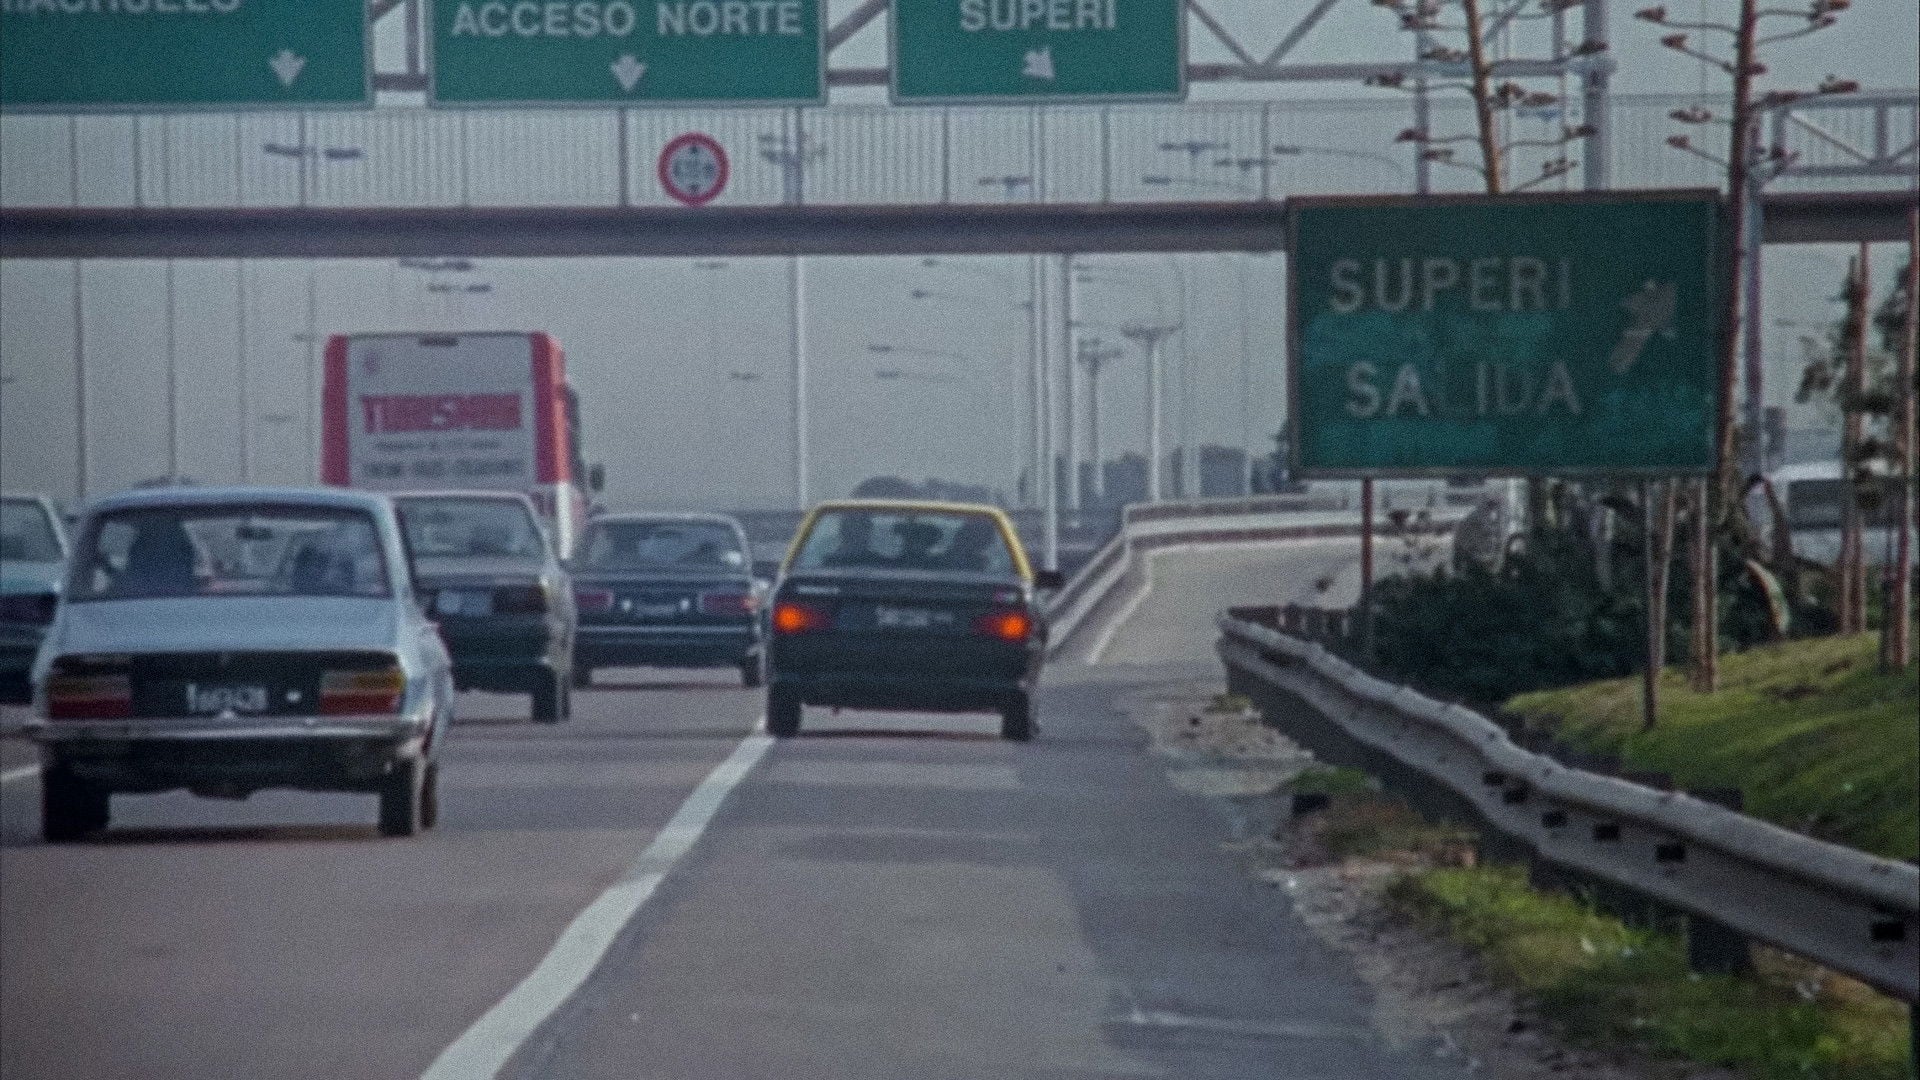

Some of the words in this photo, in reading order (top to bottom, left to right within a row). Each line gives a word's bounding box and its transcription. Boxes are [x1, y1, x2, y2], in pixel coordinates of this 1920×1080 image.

[451, 1, 636, 37] ACCESO
[656, 0, 803, 35] NORTE
[960, 0, 1117, 31] SUPERI
[1328, 256, 1571, 313] SUPERI
[1345, 360, 1583, 419] SALIDA
